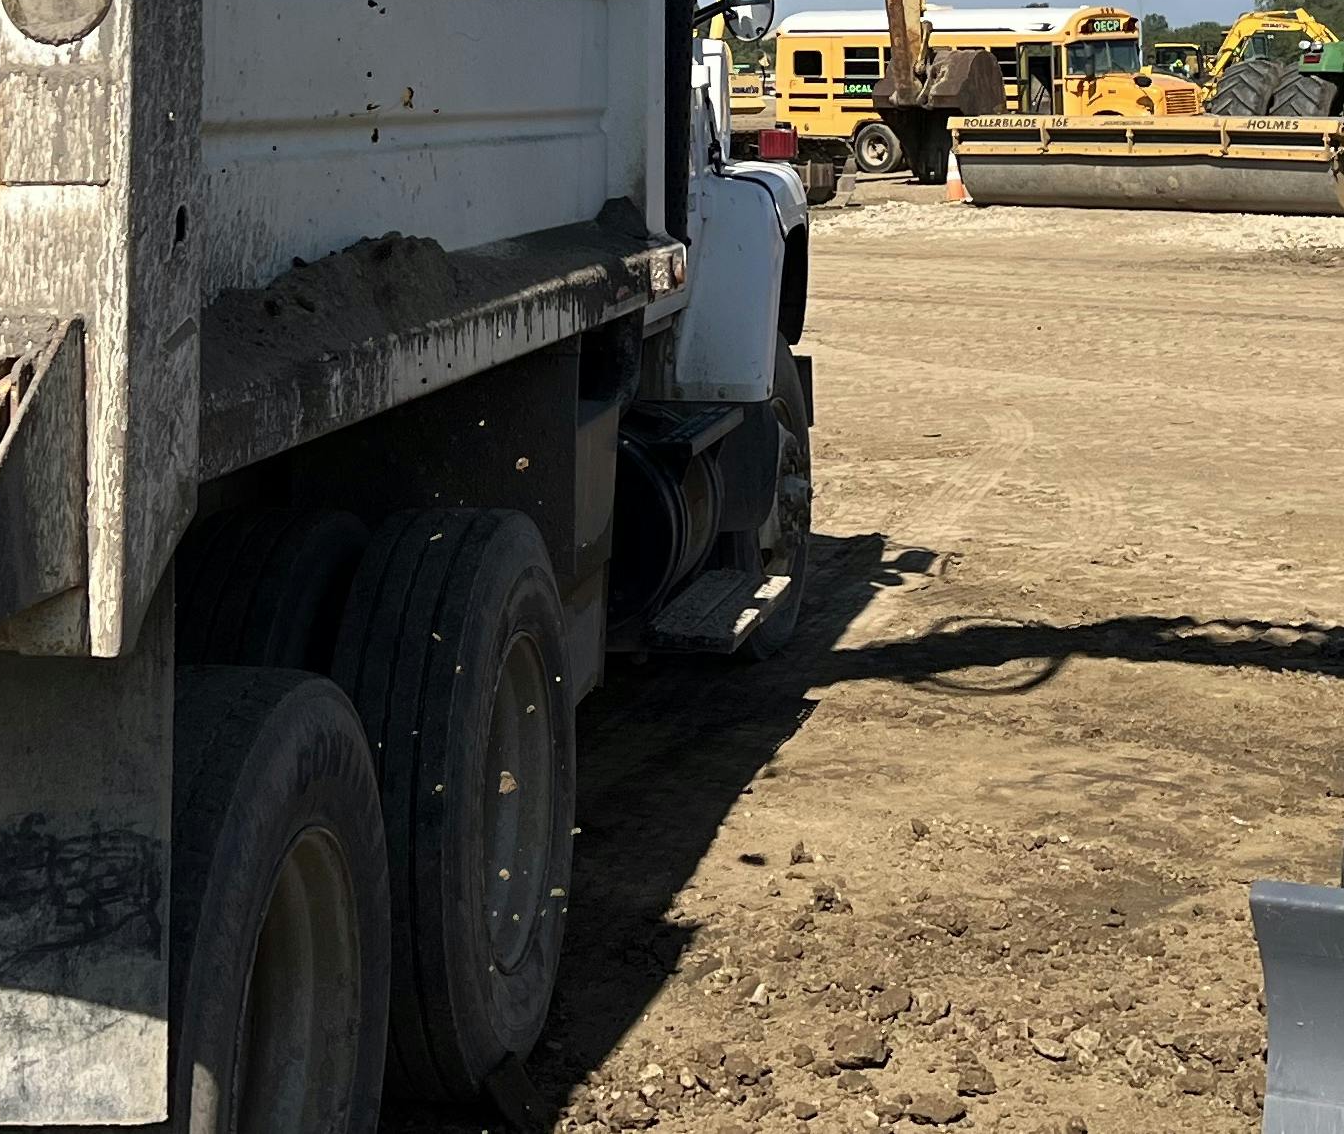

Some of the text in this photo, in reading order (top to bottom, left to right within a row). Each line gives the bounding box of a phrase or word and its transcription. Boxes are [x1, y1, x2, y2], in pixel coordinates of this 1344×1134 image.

[844, 84, 873, 93] LOCAL
[963, 118, 1038, 128] ROLLERBLADE
[1246, 119, 1300, 131] HOLMES
